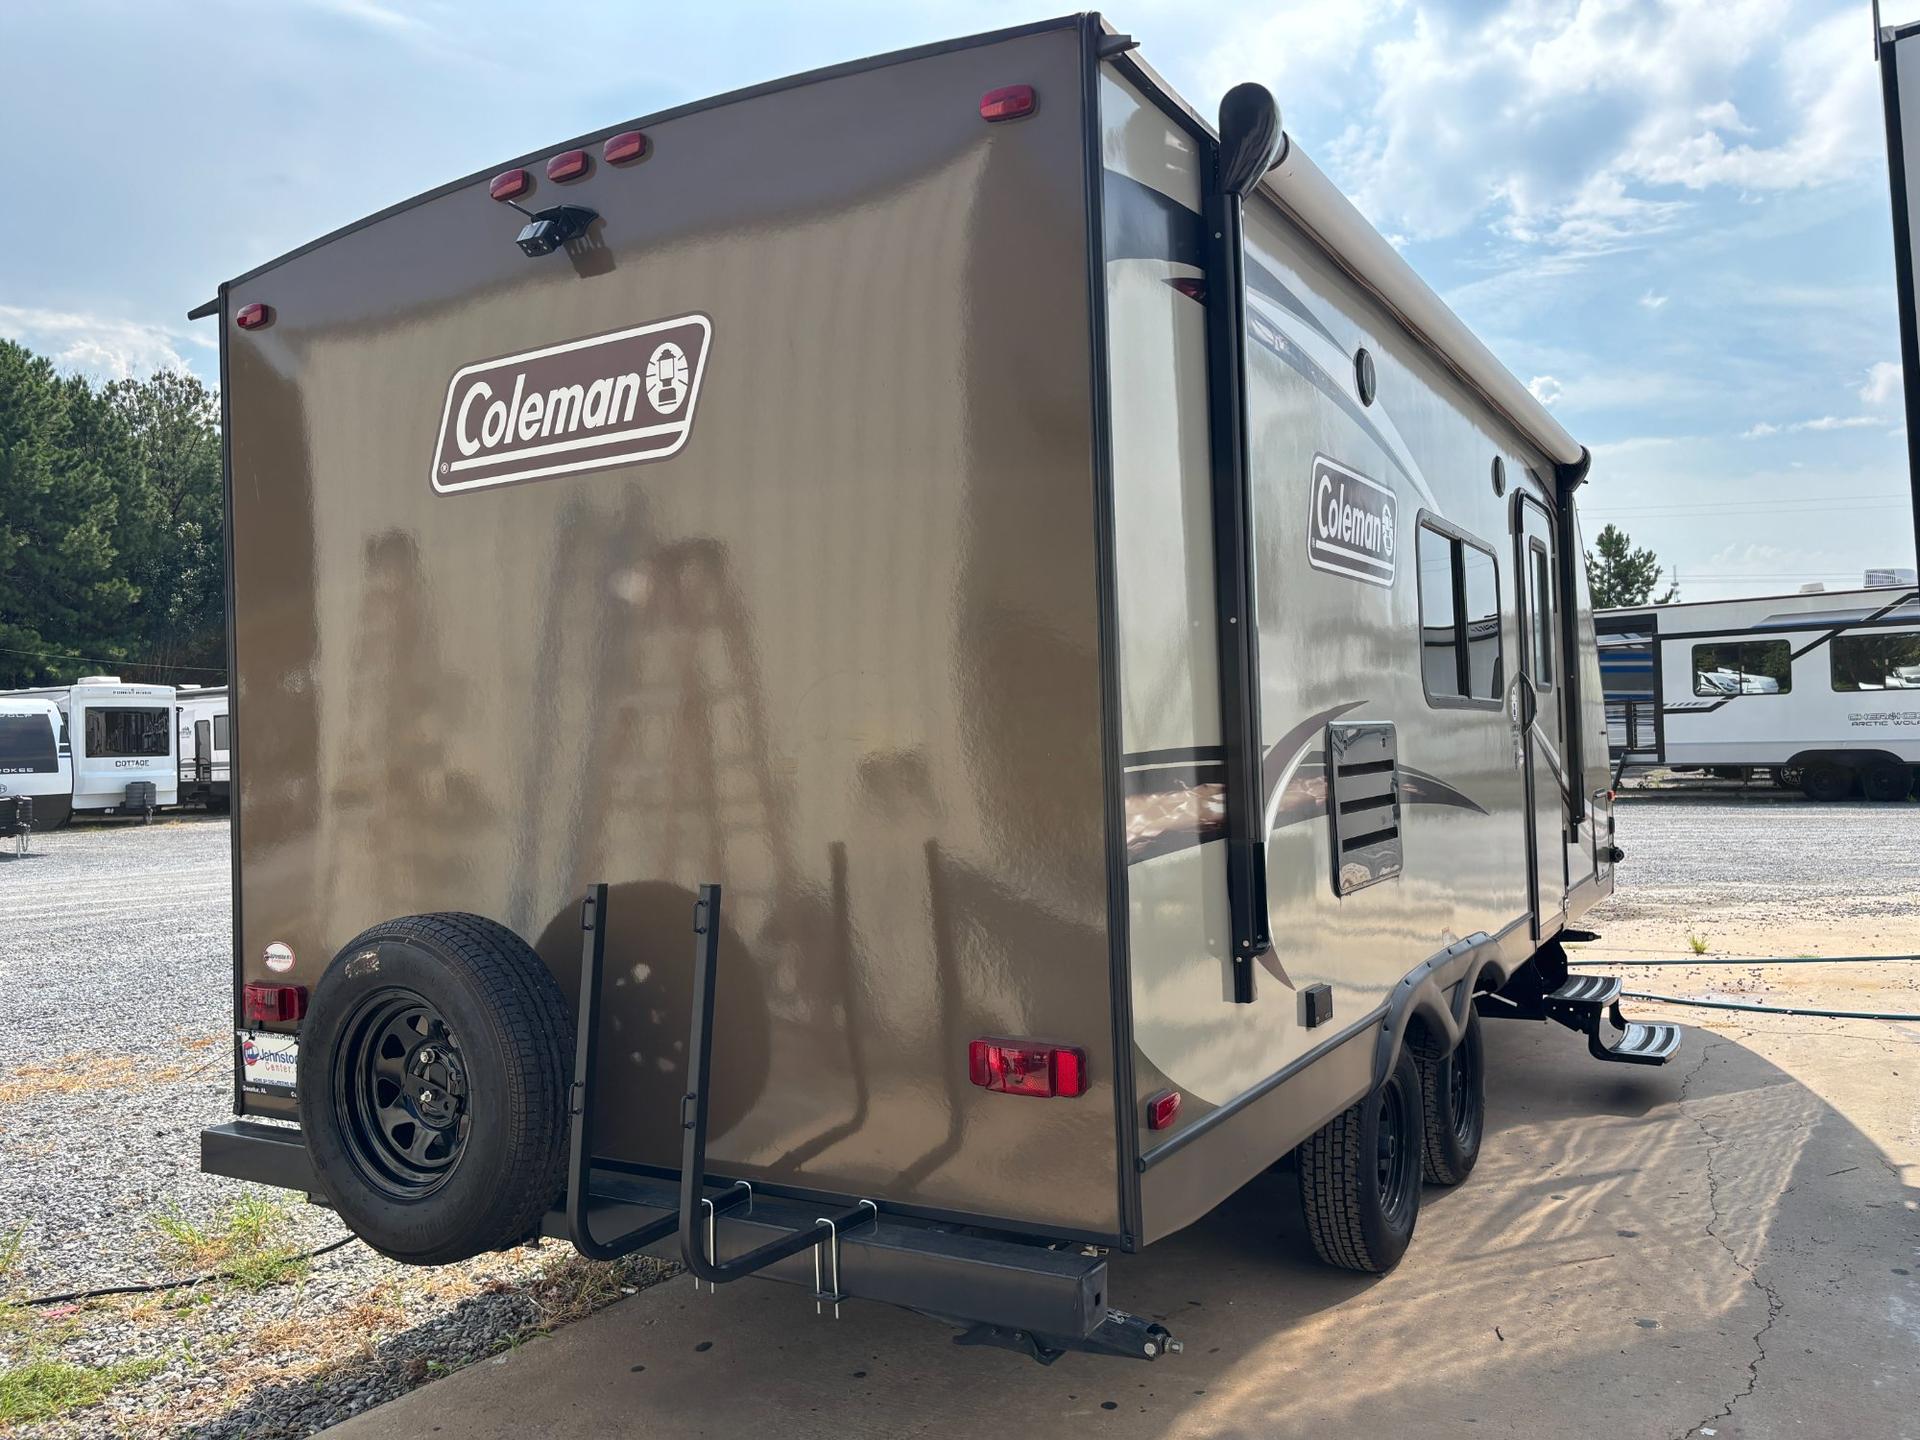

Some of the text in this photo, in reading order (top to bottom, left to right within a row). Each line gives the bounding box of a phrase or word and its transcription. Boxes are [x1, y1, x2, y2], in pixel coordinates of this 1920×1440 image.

[456, 373, 640, 456] Coleman
[1317, 474, 1381, 552] Coleman
[115, 760, 150, 768] COTTAGE
